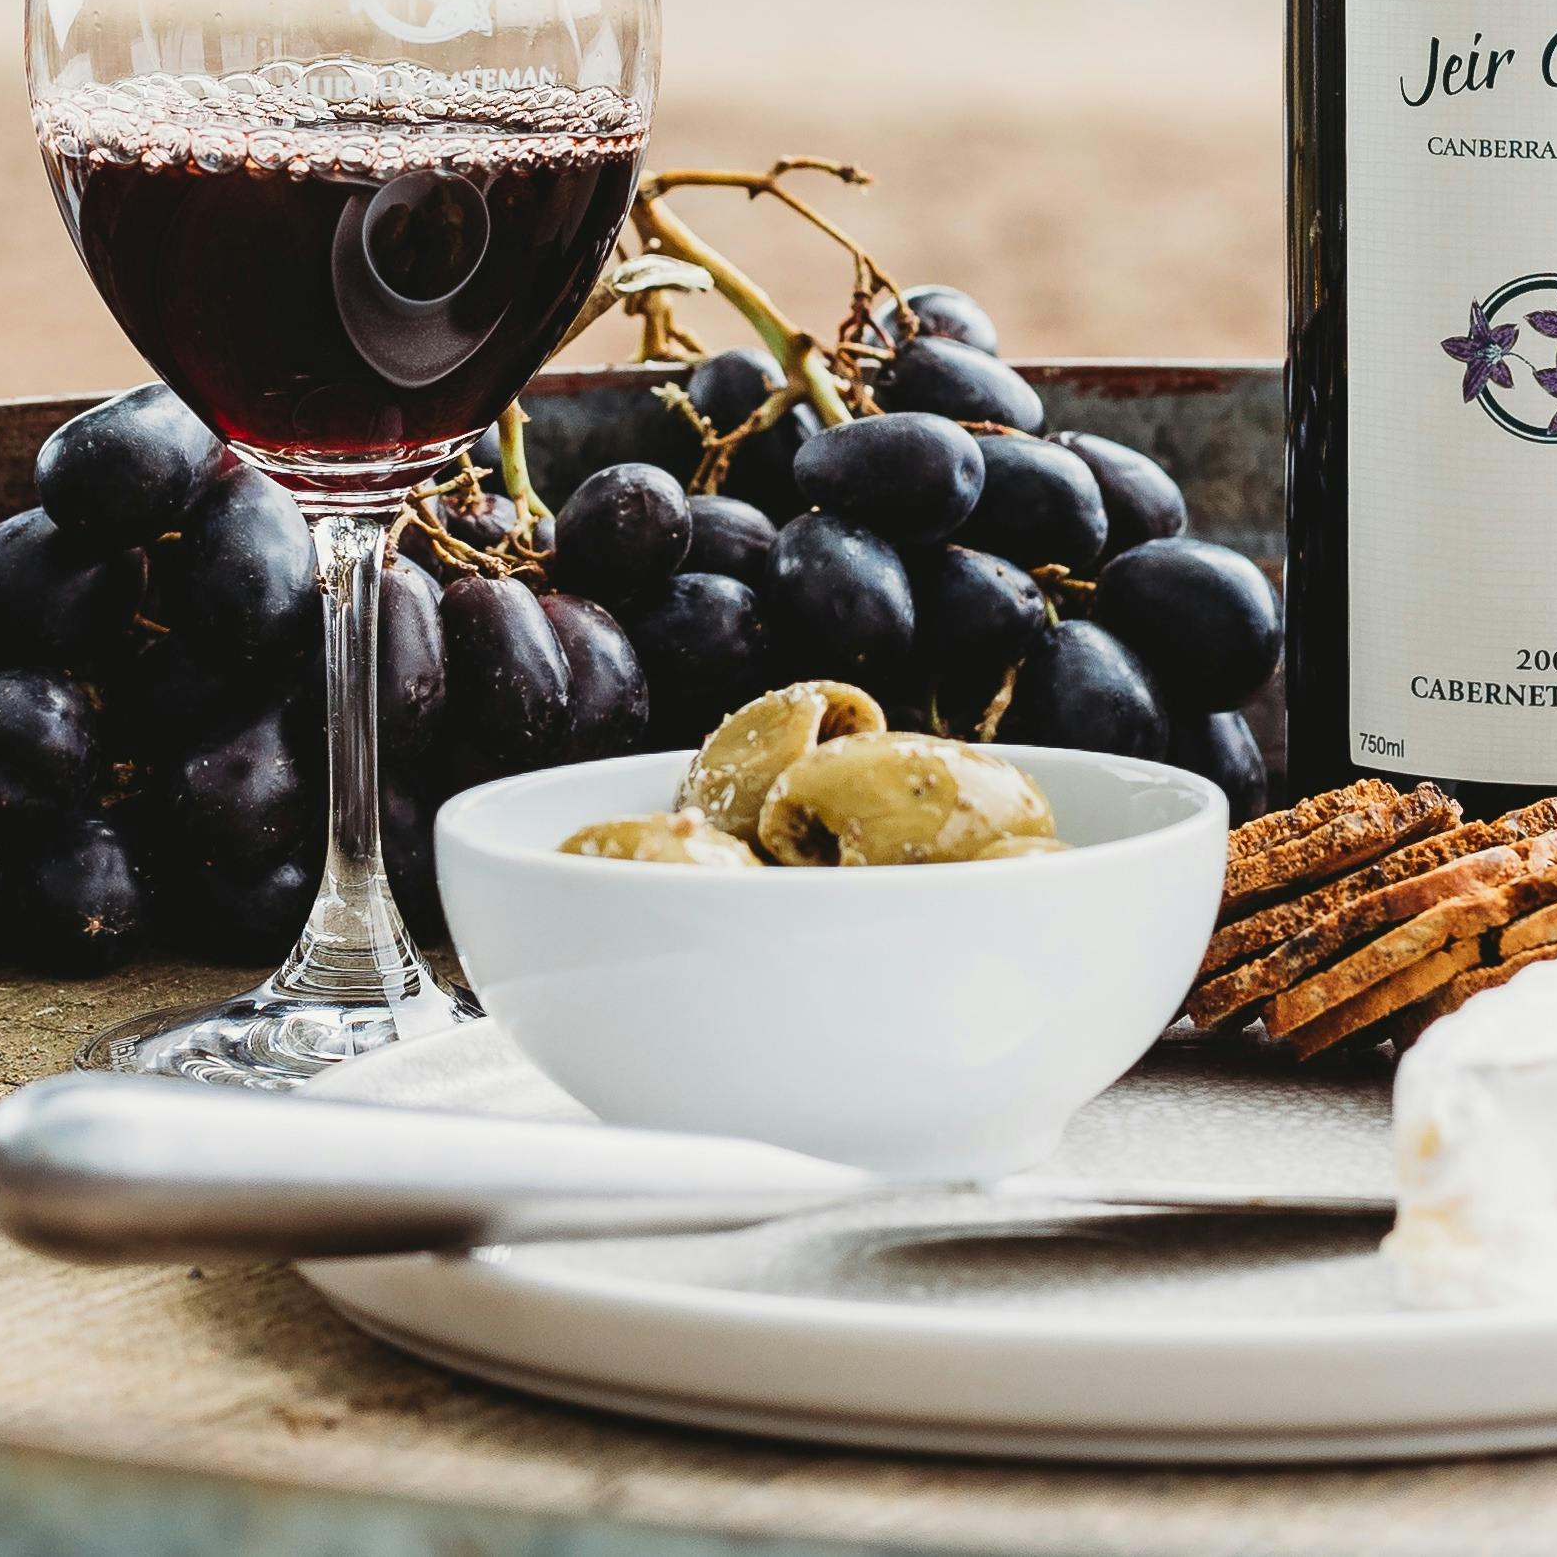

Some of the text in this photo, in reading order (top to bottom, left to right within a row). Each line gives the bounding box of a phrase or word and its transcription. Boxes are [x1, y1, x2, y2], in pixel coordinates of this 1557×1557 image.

[282, 65, 556, 99] URUATEMAN
[1399, 32, 1516, 108] Jeir
[1358, 732, 1406, 759] 750ml
